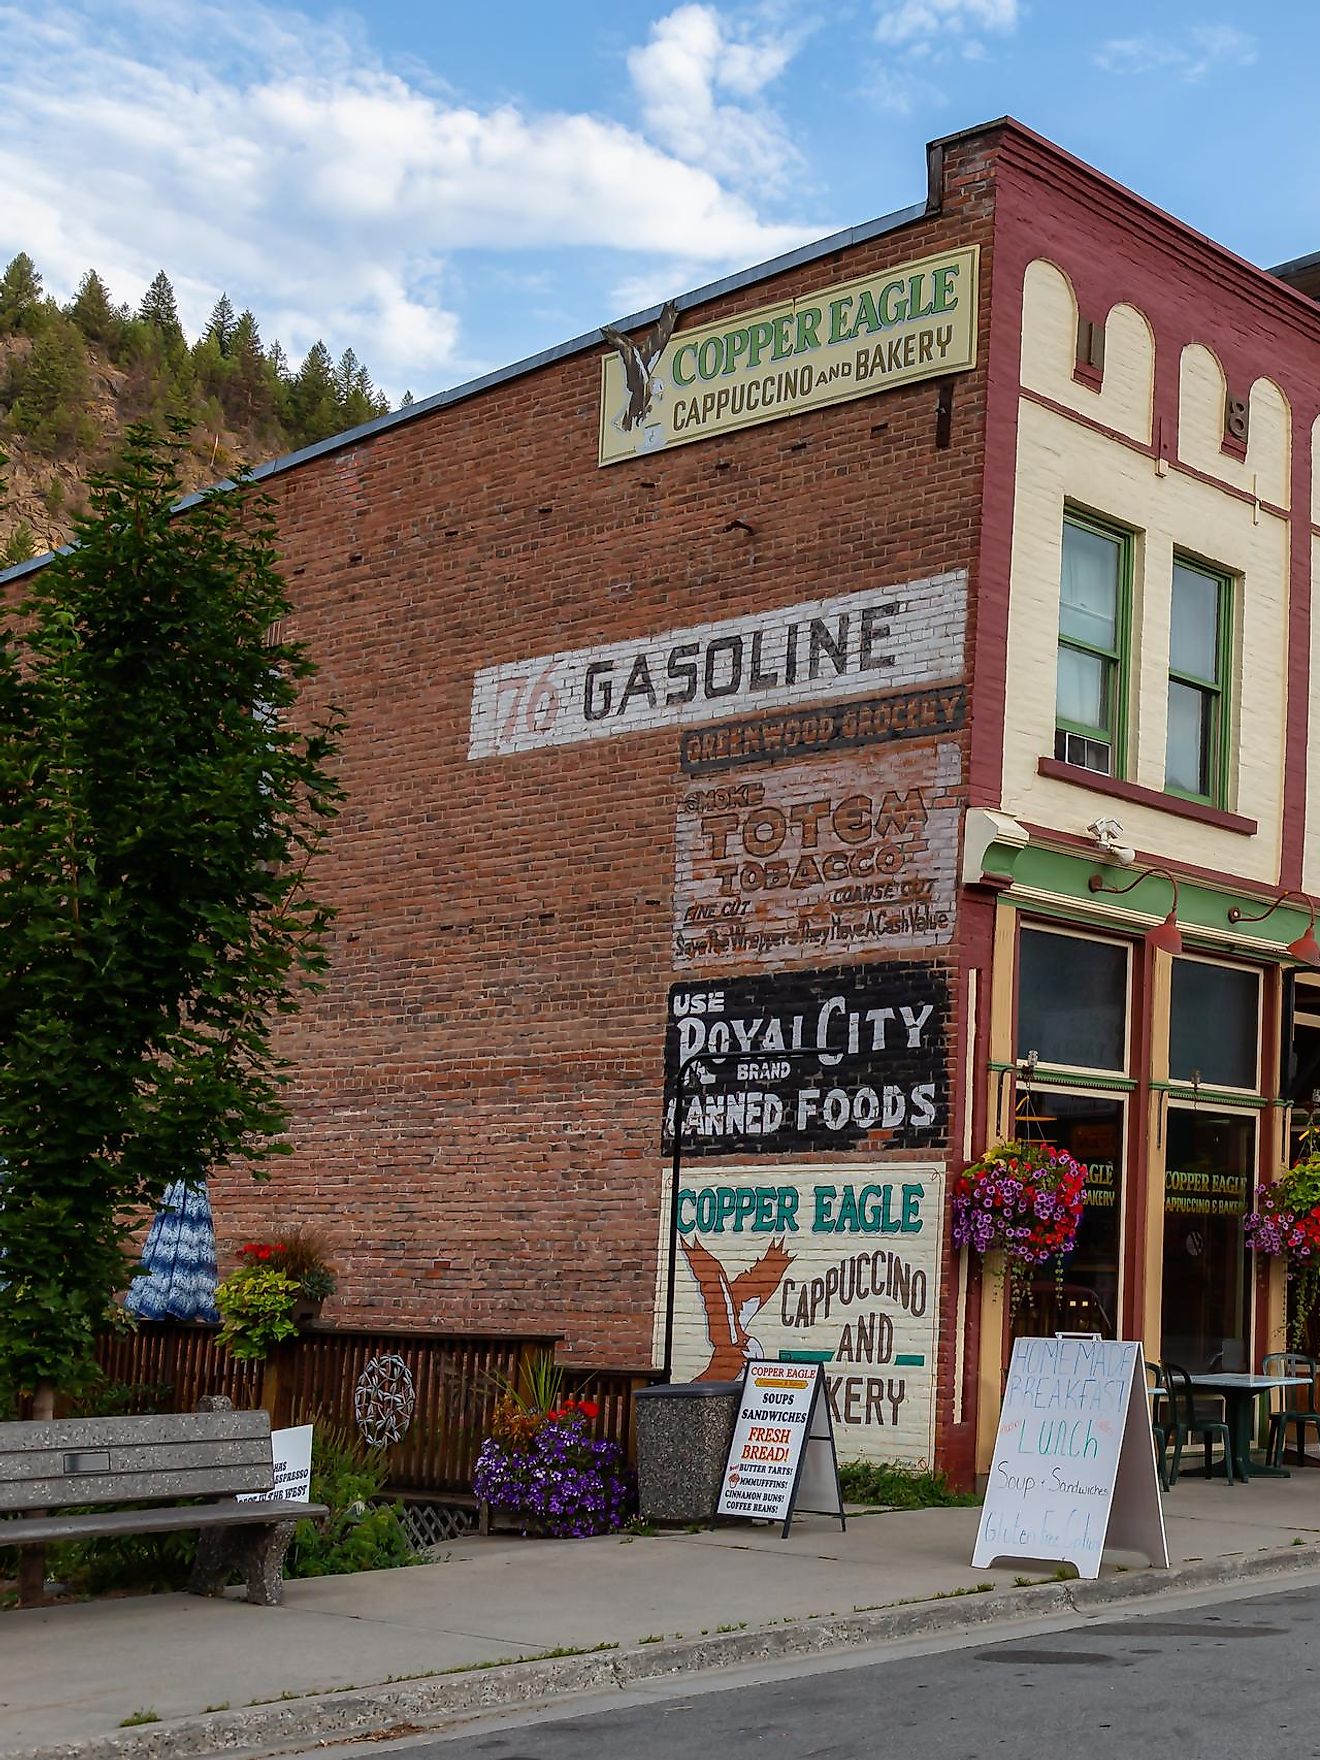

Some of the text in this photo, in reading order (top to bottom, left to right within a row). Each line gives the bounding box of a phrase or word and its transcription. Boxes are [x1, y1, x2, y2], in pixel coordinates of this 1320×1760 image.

[672, 264, 960, 387] COPPER EAGLE
[673, 324, 953, 432] CAPPUCCINO AND BAKERY
[583, 600, 902, 722] GASOLINE
[684, 783, 765, 814] SMOKE
[701, 787, 929, 860] TOTEM
[715, 845, 906, 896] TOBACCO
[722, 901, 750, 917] CUT
[673, 991, 725, 1017] USE
[816, 996, 934, 1066] CITY
[736, 1061, 791, 1082] BRAND
[797, 1083, 936, 1131] FOODS
[1165, 1170, 1248, 1194] COPPER EAGLE
[676, 1182, 926, 1236] COPPER EAGLE
[1165, 1196, 1211, 1213] APPUCCINO
[780, 1250, 928, 1328] CAPPUCCINO
[835, 1312, 894, 1366] AND
[751, 1366, 817, 1379] COPPER EAGLE
[762, 1392, 795, 1406] SOUPS
[823, 1376, 906, 1427] KERY
[1007, 1374, 1126, 1412] BREAKFAST
[741, 1408, 808, 1424] SANDWICHES
[748, 1426, 791, 1444] FRESH
[741, 1444, 790, 1463] BREAD!
[273, 1461, 288, 1473] HAS
[274, 1468, 309, 1485] ESPRESSO
[739, 1463, 767, 1473] BUTTER
[768, 1465, 794, 1476] TARTS!
[997, 1460, 1110, 1499] Soup Sandwiches
[285, 1484, 308, 1501] WEST
[725, 1489, 786, 1503] CINNAMON BUNS!
[726, 1500, 779, 1514] COFFEE BEANS!
